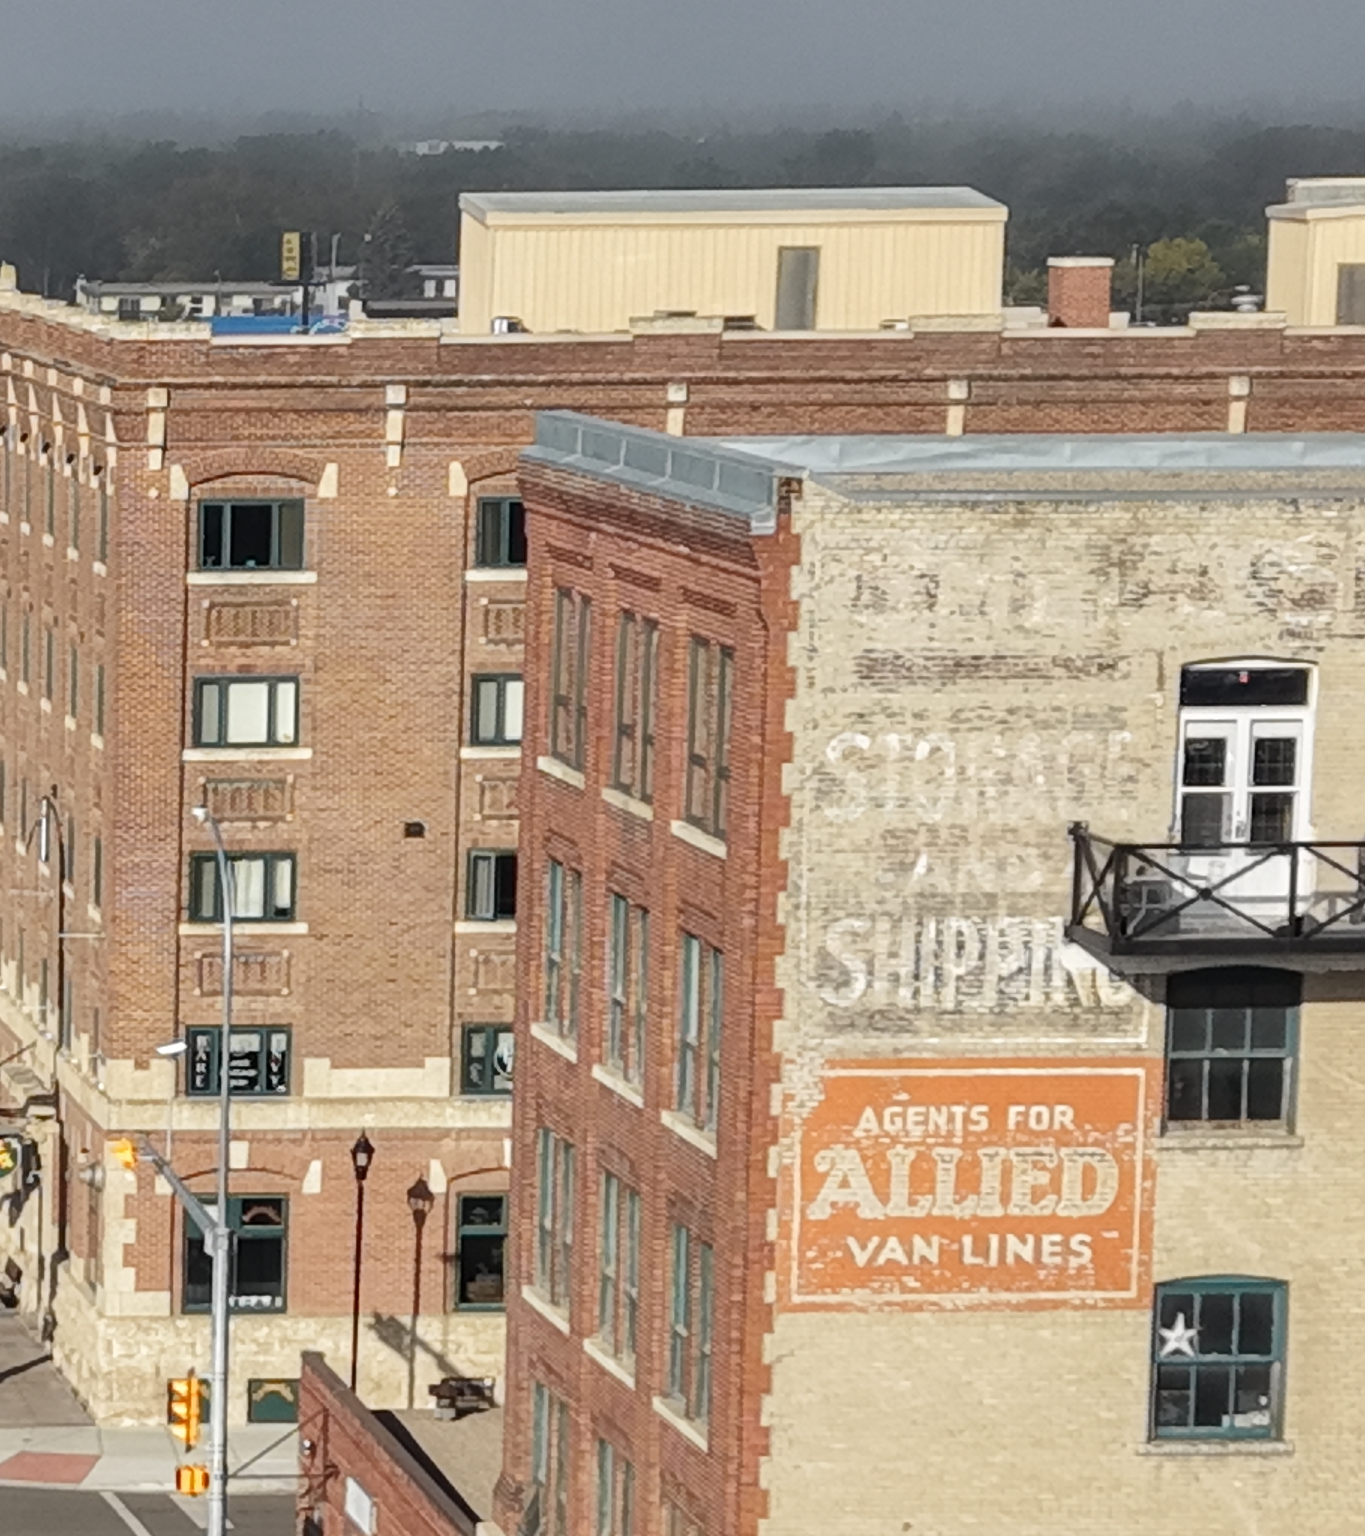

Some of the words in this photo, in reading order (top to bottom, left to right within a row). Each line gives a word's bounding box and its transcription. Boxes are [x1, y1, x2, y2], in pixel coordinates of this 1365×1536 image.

[853, 1104, 990, 1141] AGENTS
[1007, 1105, 1075, 1133] FOR
[806, 1144, 1120, 1221] ALLIED
[847, 1235, 941, 1268] VAN
[961, 1233, 1094, 1268] LINES
